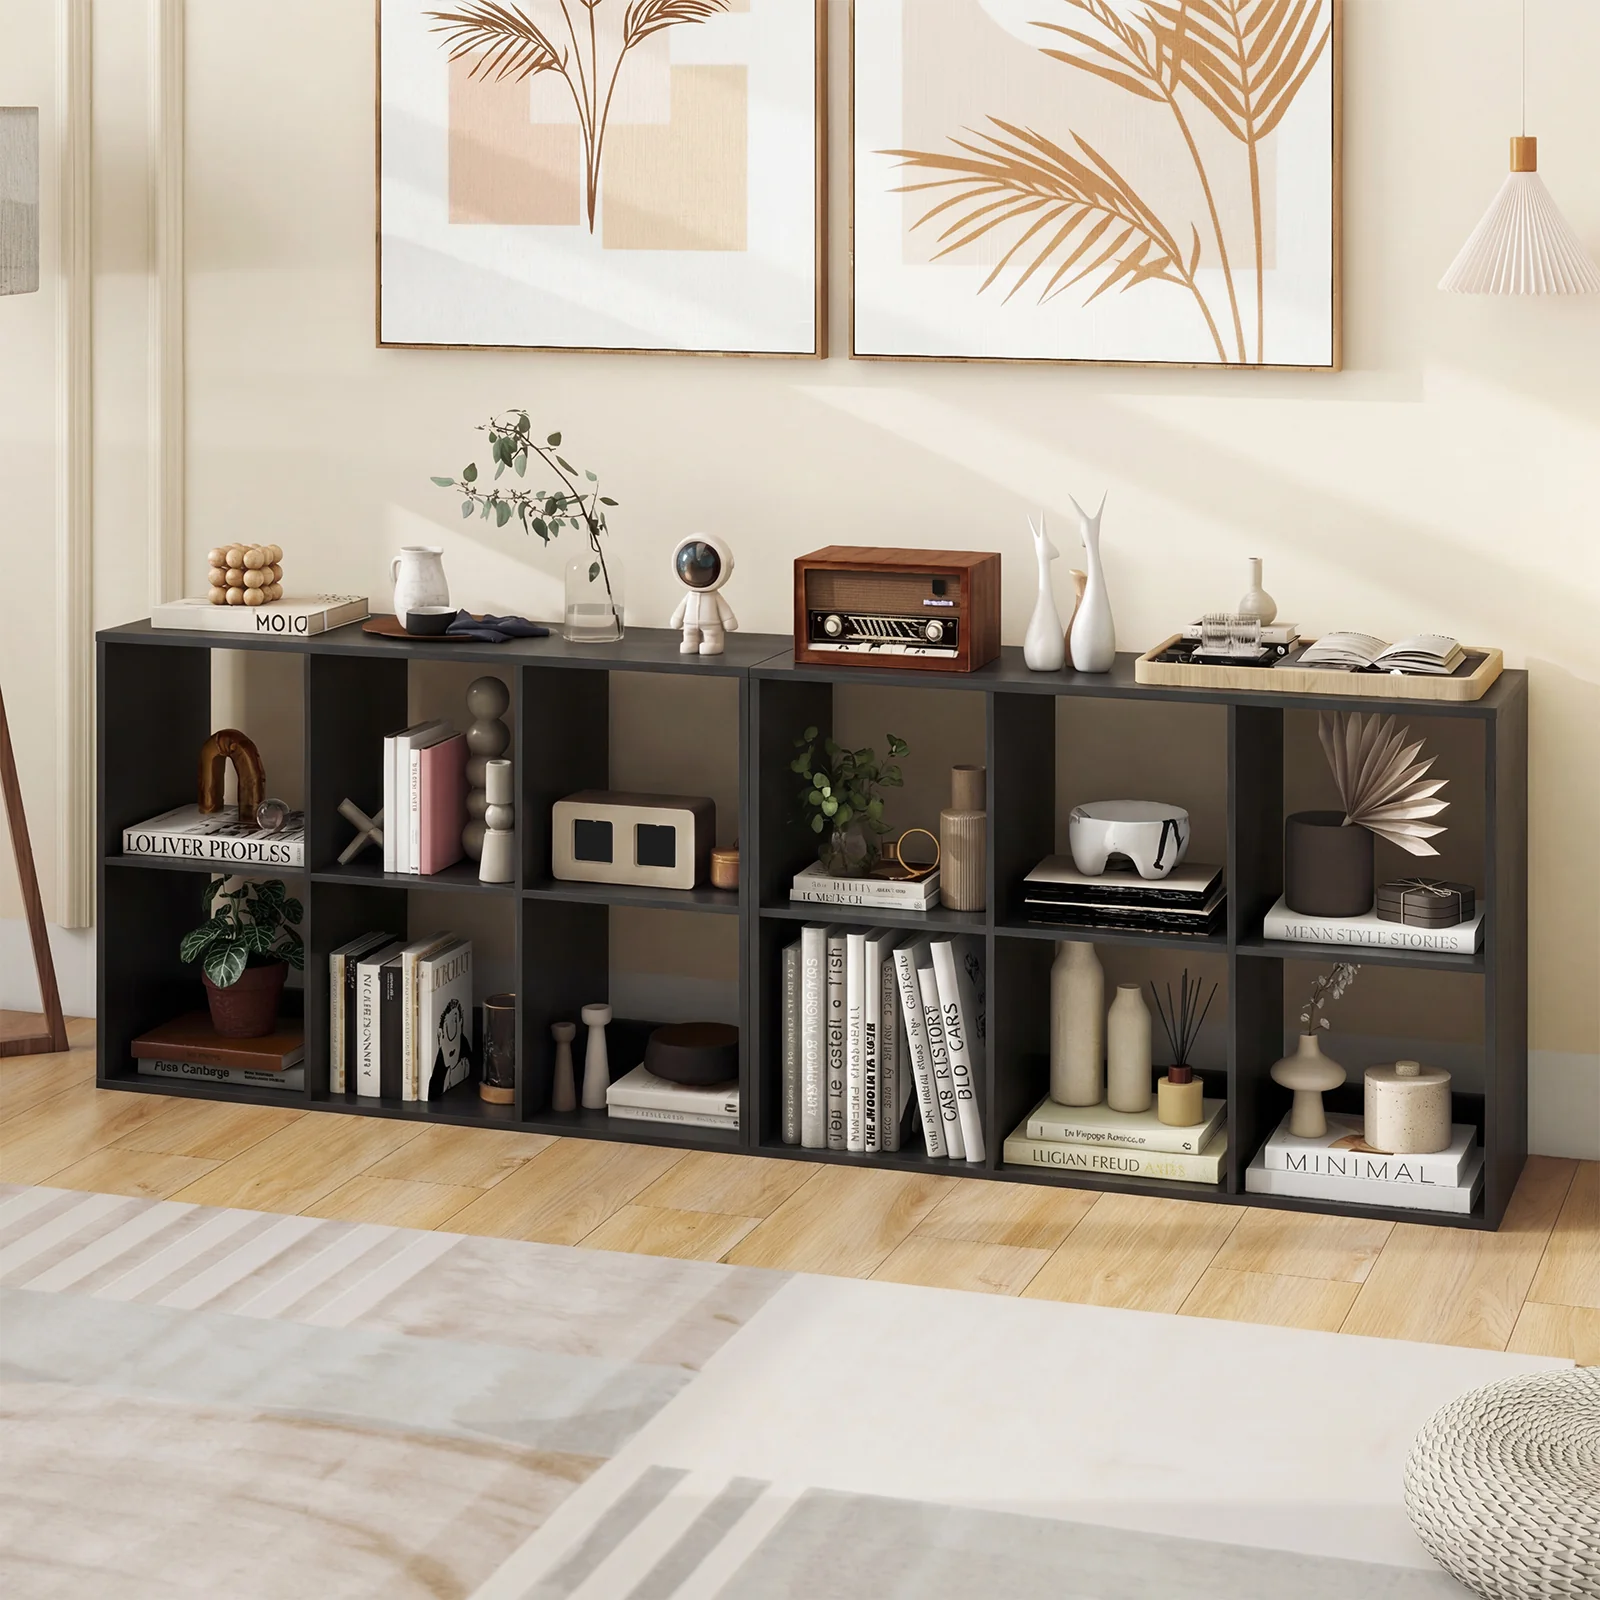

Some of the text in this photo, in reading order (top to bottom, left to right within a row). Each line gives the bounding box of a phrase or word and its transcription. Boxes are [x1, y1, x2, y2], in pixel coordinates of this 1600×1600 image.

[1336, 928, 1386, 945] STYLE
[1390, 932, 1459, 950] STORIES
[944, 1003, 965, 1051] CARS
[1092, 1155, 1140, 1172] FREUD
[1286, 1152, 1435, 1184] MINIMAL
